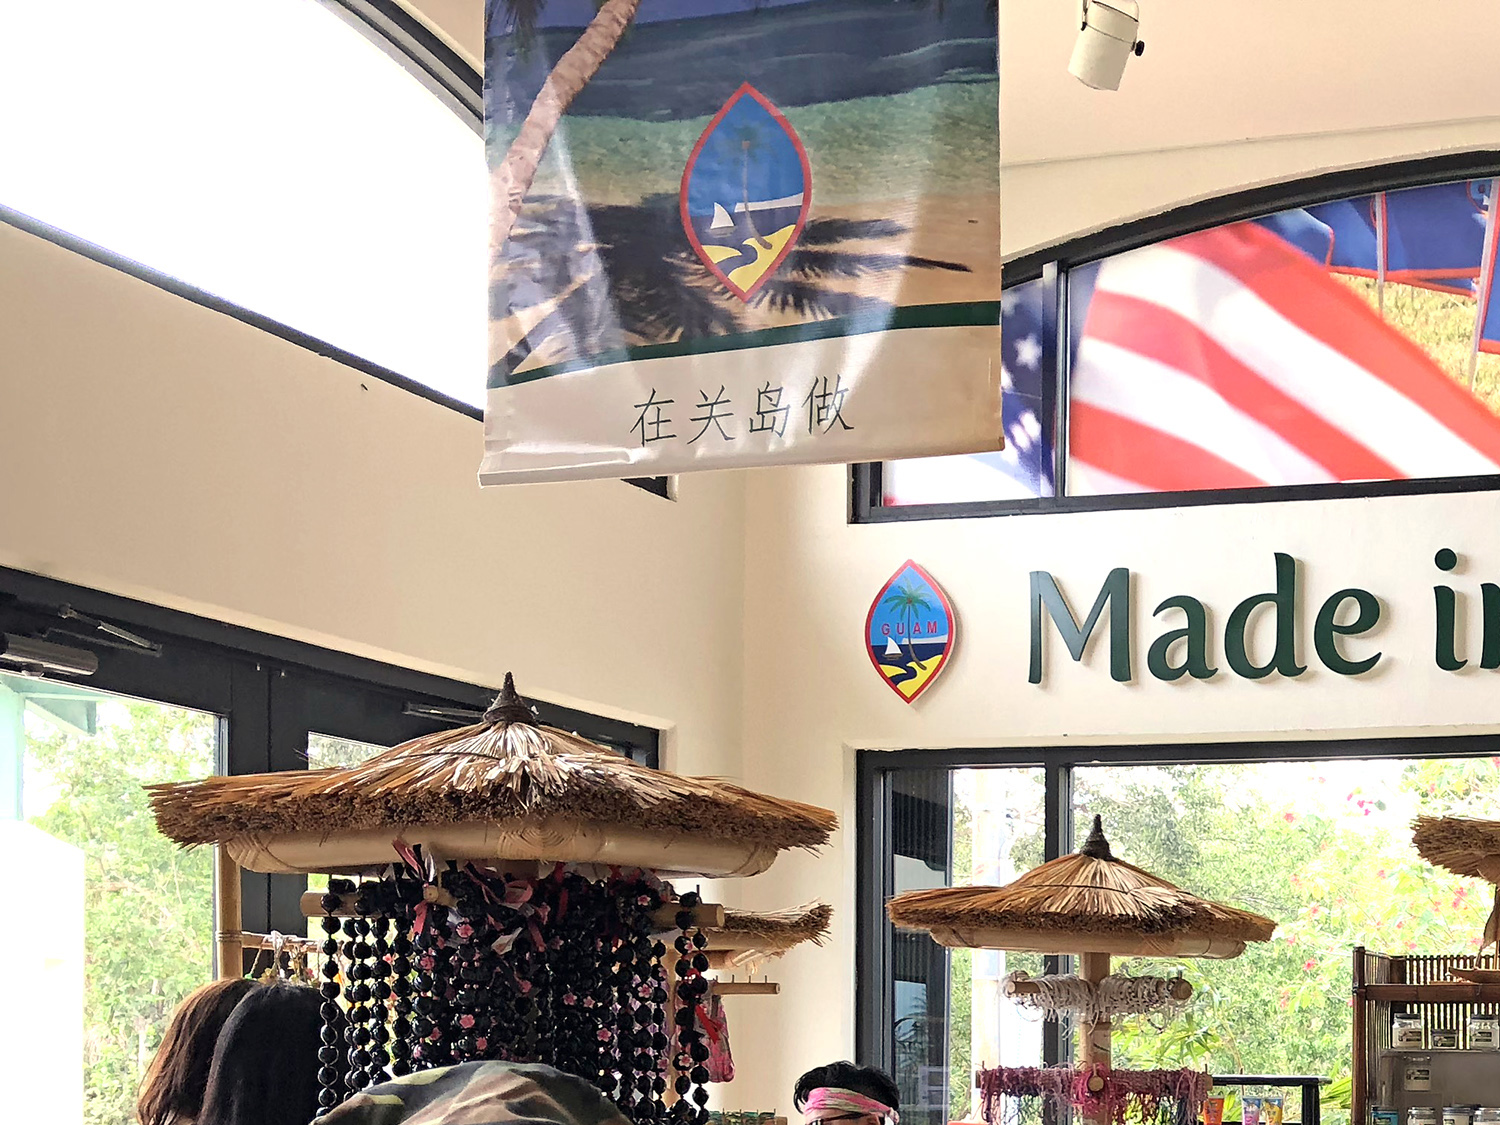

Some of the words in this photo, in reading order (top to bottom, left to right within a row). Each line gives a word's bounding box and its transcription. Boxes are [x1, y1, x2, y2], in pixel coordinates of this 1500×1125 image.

[630, 375, 854, 447] 在关岛做
[881, 620, 939, 637] GUAM
[1029, 552, 1383, 684] Made
